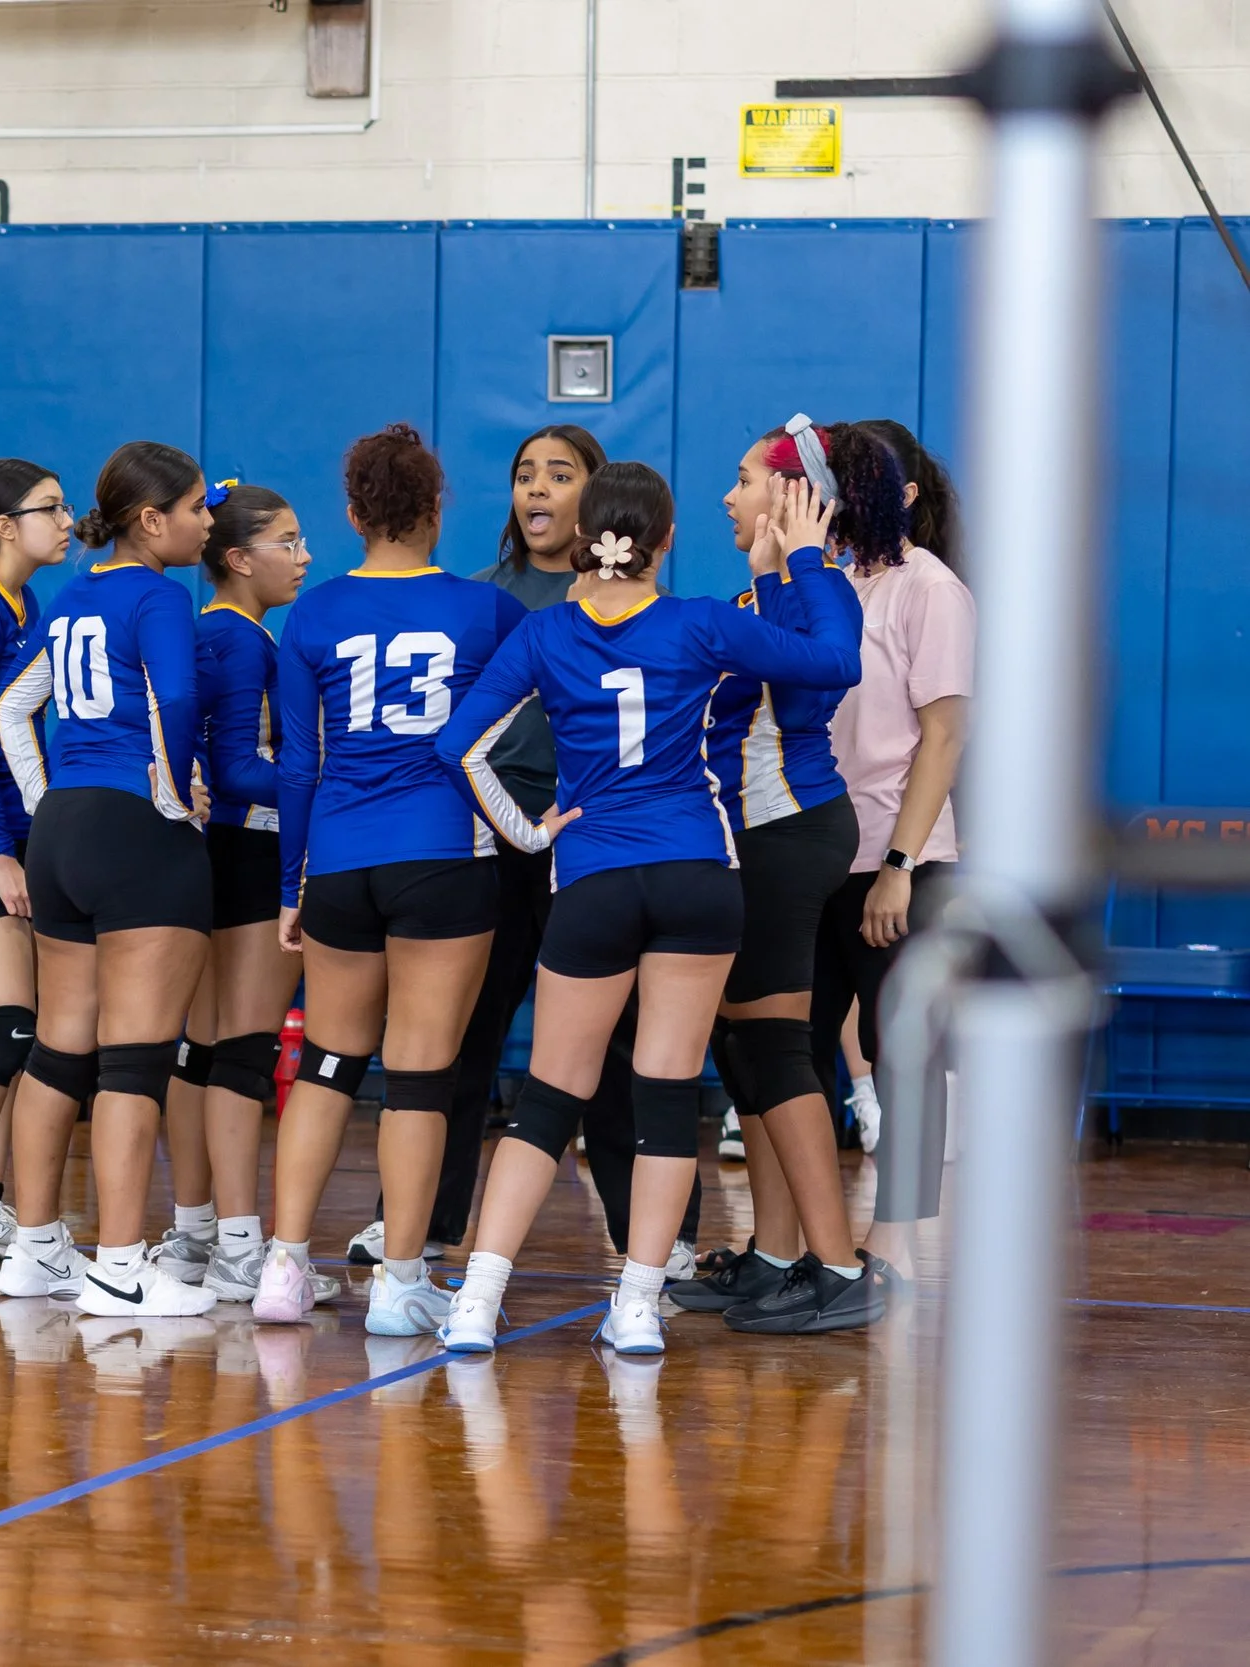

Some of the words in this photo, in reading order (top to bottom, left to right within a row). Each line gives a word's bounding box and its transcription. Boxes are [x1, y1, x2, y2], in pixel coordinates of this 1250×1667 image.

[750, 109, 830, 126] WARNING
[672, 157, 706, 220] E
[48, 615, 115, 719] 10
[336, 631, 456, 735] 13
[601, 667, 645, 768] 1
